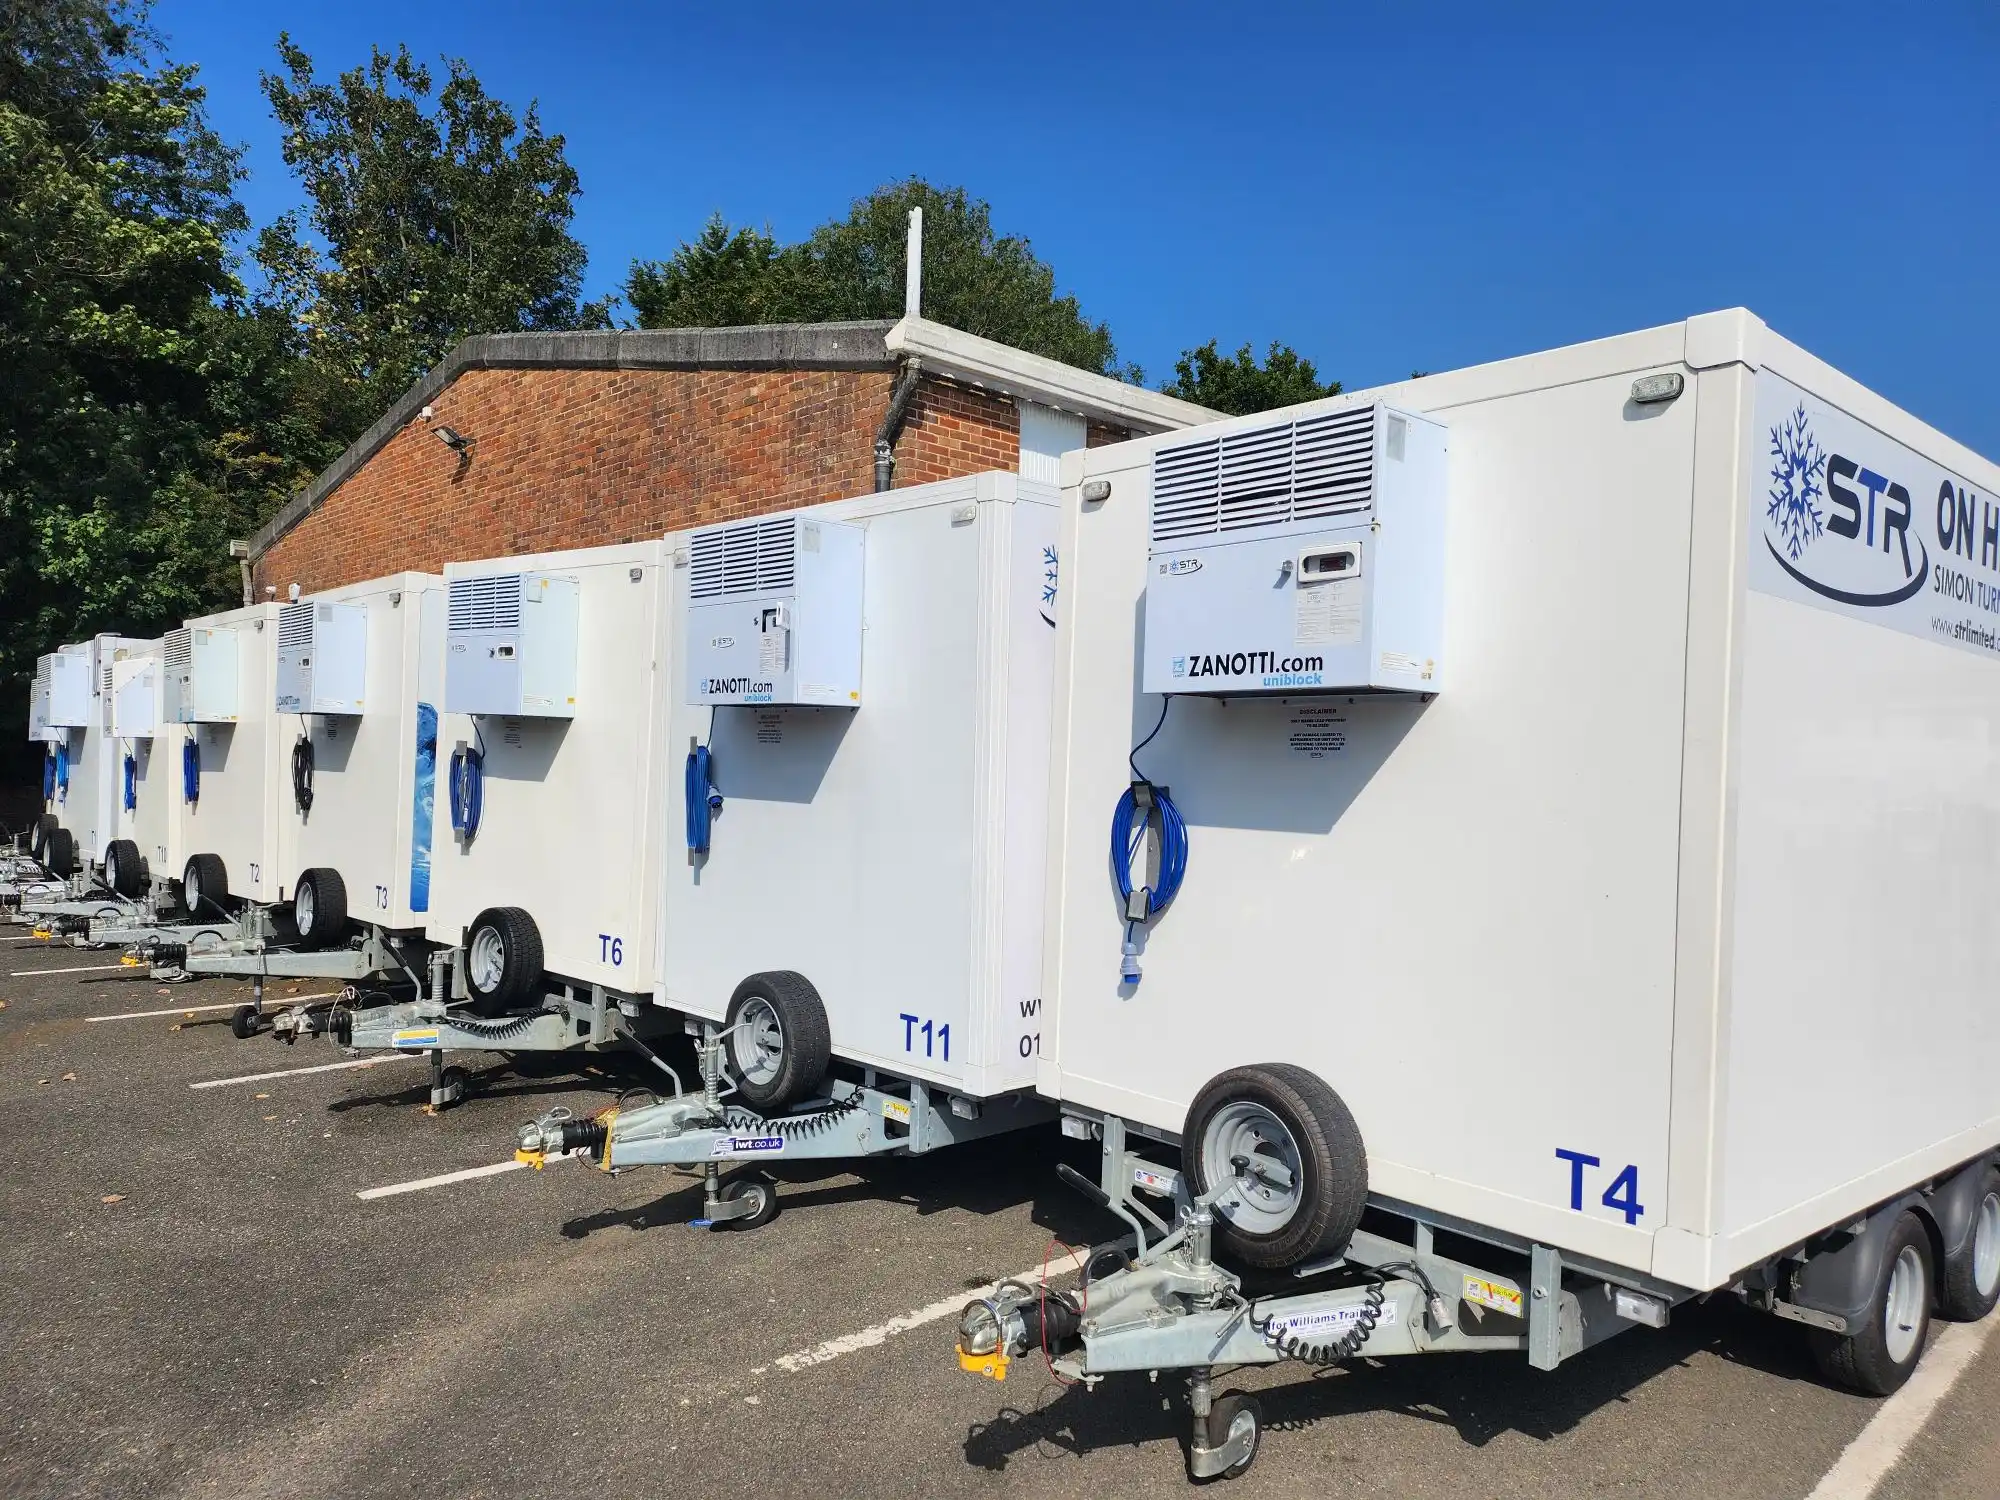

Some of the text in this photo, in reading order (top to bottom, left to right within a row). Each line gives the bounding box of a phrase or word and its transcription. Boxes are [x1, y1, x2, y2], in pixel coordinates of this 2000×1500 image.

[1826, 453, 1913, 579] STR
[1937, 479, 2000, 573] ON H
[1179, 559, 1199, 568] STR
[1934, 564, 2000, 614] SIMON TUR
[1188, 651, 1323, 677] ZANOTTI.com
[709, 677, 773, 694] ZANOTTI.com
[1263, 673, 1322, 687] uniblock
[250, 863, 260, 883] T2
[376, 885, 388, 909] T3
[598, 933, 622, 966] T6
[900, 1013, 950, 1062] T11
[735, 1138, 781, 1150] iwt.co.uk
[1555, 1147, 1645, 1226] T4
[1290, 1313, 1336, 1328] Williams
